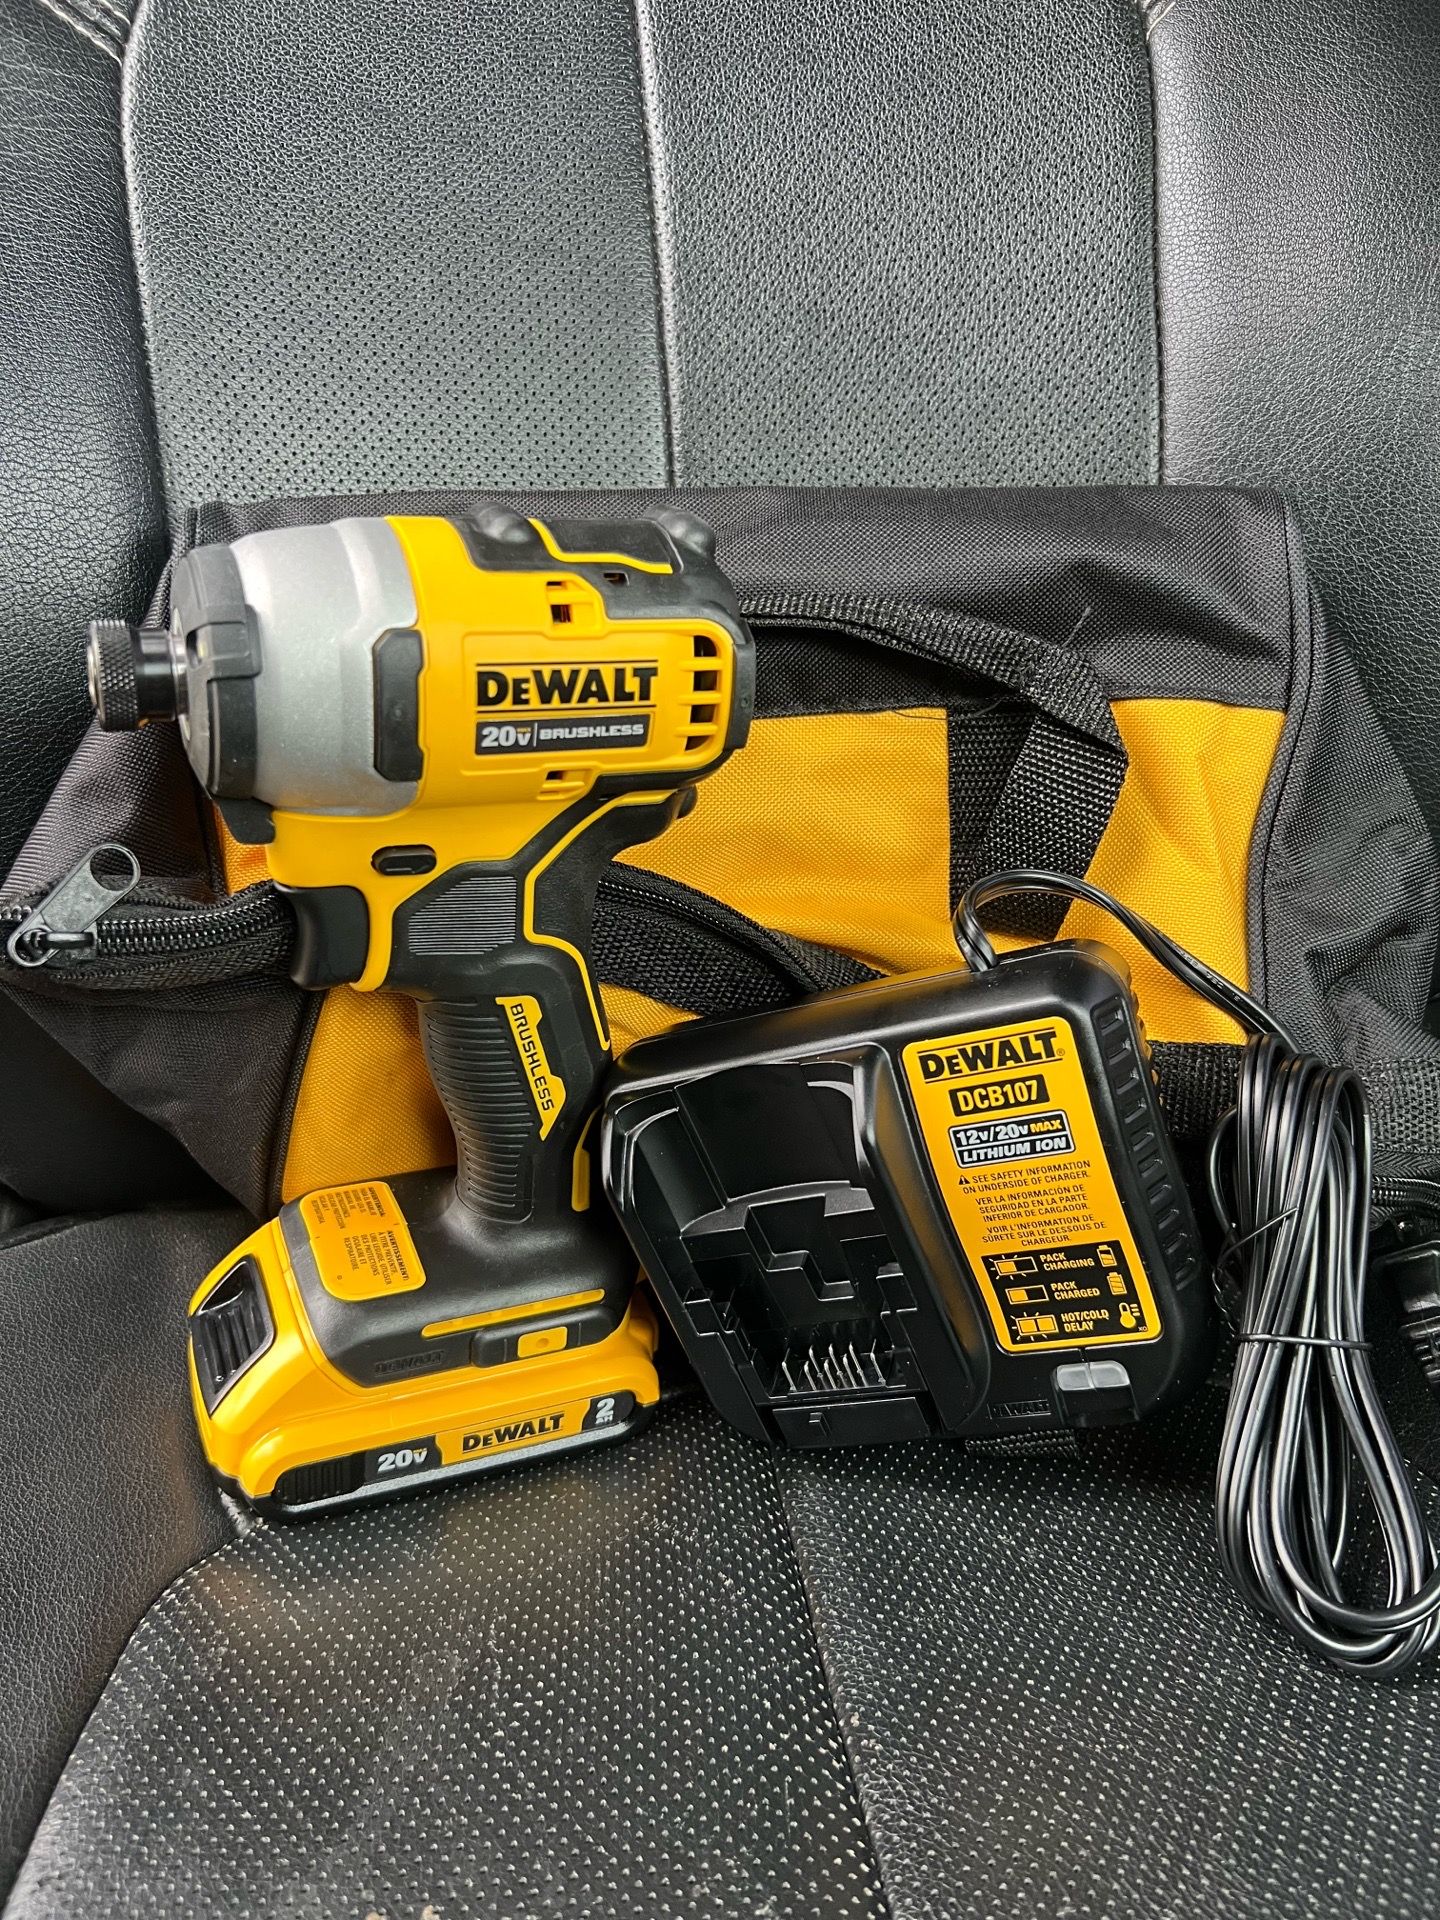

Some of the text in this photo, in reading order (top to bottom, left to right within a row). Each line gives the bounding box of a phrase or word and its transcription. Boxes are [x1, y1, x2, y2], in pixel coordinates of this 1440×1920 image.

[540, 724, 644, 740] BRUSHLESS
[510, 1003, 554, 1111] BRUSHLESS
[956, 1080, 1038, 1112] DCB107
[1030, 1120, 1062, 1133] MAX
[963, 1136, 1067, 1162] LITHIUM ION
[972, 1160, 1091, 1184] SEE SAFETY INFORMATION
[979, 1178, 1029, 1192] UNDERSIDE
[1031, 1177, 1042, 1185] OF
[1045, 1170, 1090, 1183] CHARGER.
[976, 1184, 1085, 1205] VER LA INFORMACIÓN DE
[979, 1202, 1029, 1214] SEGURIDAD
[1046, 1197, 1057, 1205] LA
[1059, 1193, 1088, 1203] PARTE
[983, 1203, 1090, 1222] INFERIOR DE CARGADOR.
[987, 1214, 1094, 1234] VOIR L'INFORMATION DE
[1017, 1231, 1035, 1239] SUR
[1050, 1224, 1092, 1235] DESSOUS
[1040, 1252, 1067, 1263] PACK
[1043, 1258, 1095, 1271] CHARGING
[1051, 1281, 1077, 1291] PACK
[1055, 1288, 1100, 1300] CHARGED
[1061, 1309, 1109, 1322] HOT/COLD
[1064, 1321, 1094, 1332] DELAY
[596, 1398, 614, 1418] 2
